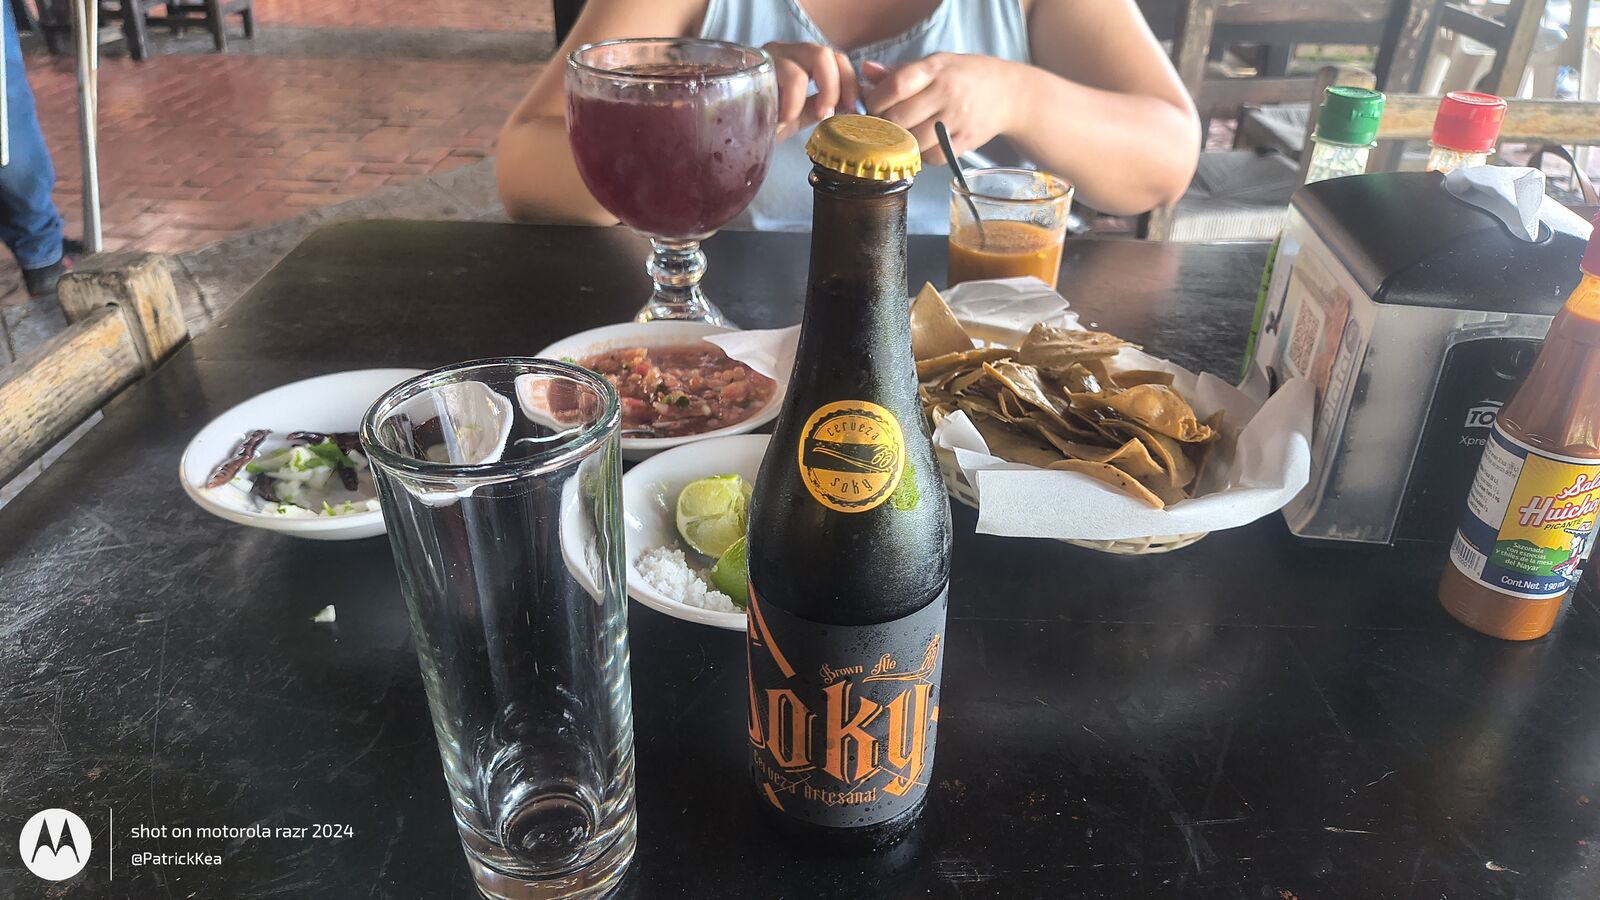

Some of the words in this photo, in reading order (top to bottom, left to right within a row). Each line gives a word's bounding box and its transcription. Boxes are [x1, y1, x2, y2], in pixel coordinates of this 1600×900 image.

[830, 477, 873, 495] soky
[1556, 471, 1600, 500] Sal
[1519, 493, 1600, 528] Huicho
[1544, 517, 1583, 531] PICANTE
[1501, 549, 1519, 560] chiles
[1506, 546, 1518, 555] con
[1519, 549, 1546, 560] especias
[1513, 542, 1544, 554] Sazonada
[1516, 562, 1540, 572] Nayar
[820, 663, 863, 684] Brown
[870, 653, 897, 675] Ale
[804, 786, 877, 805] Artesanal
